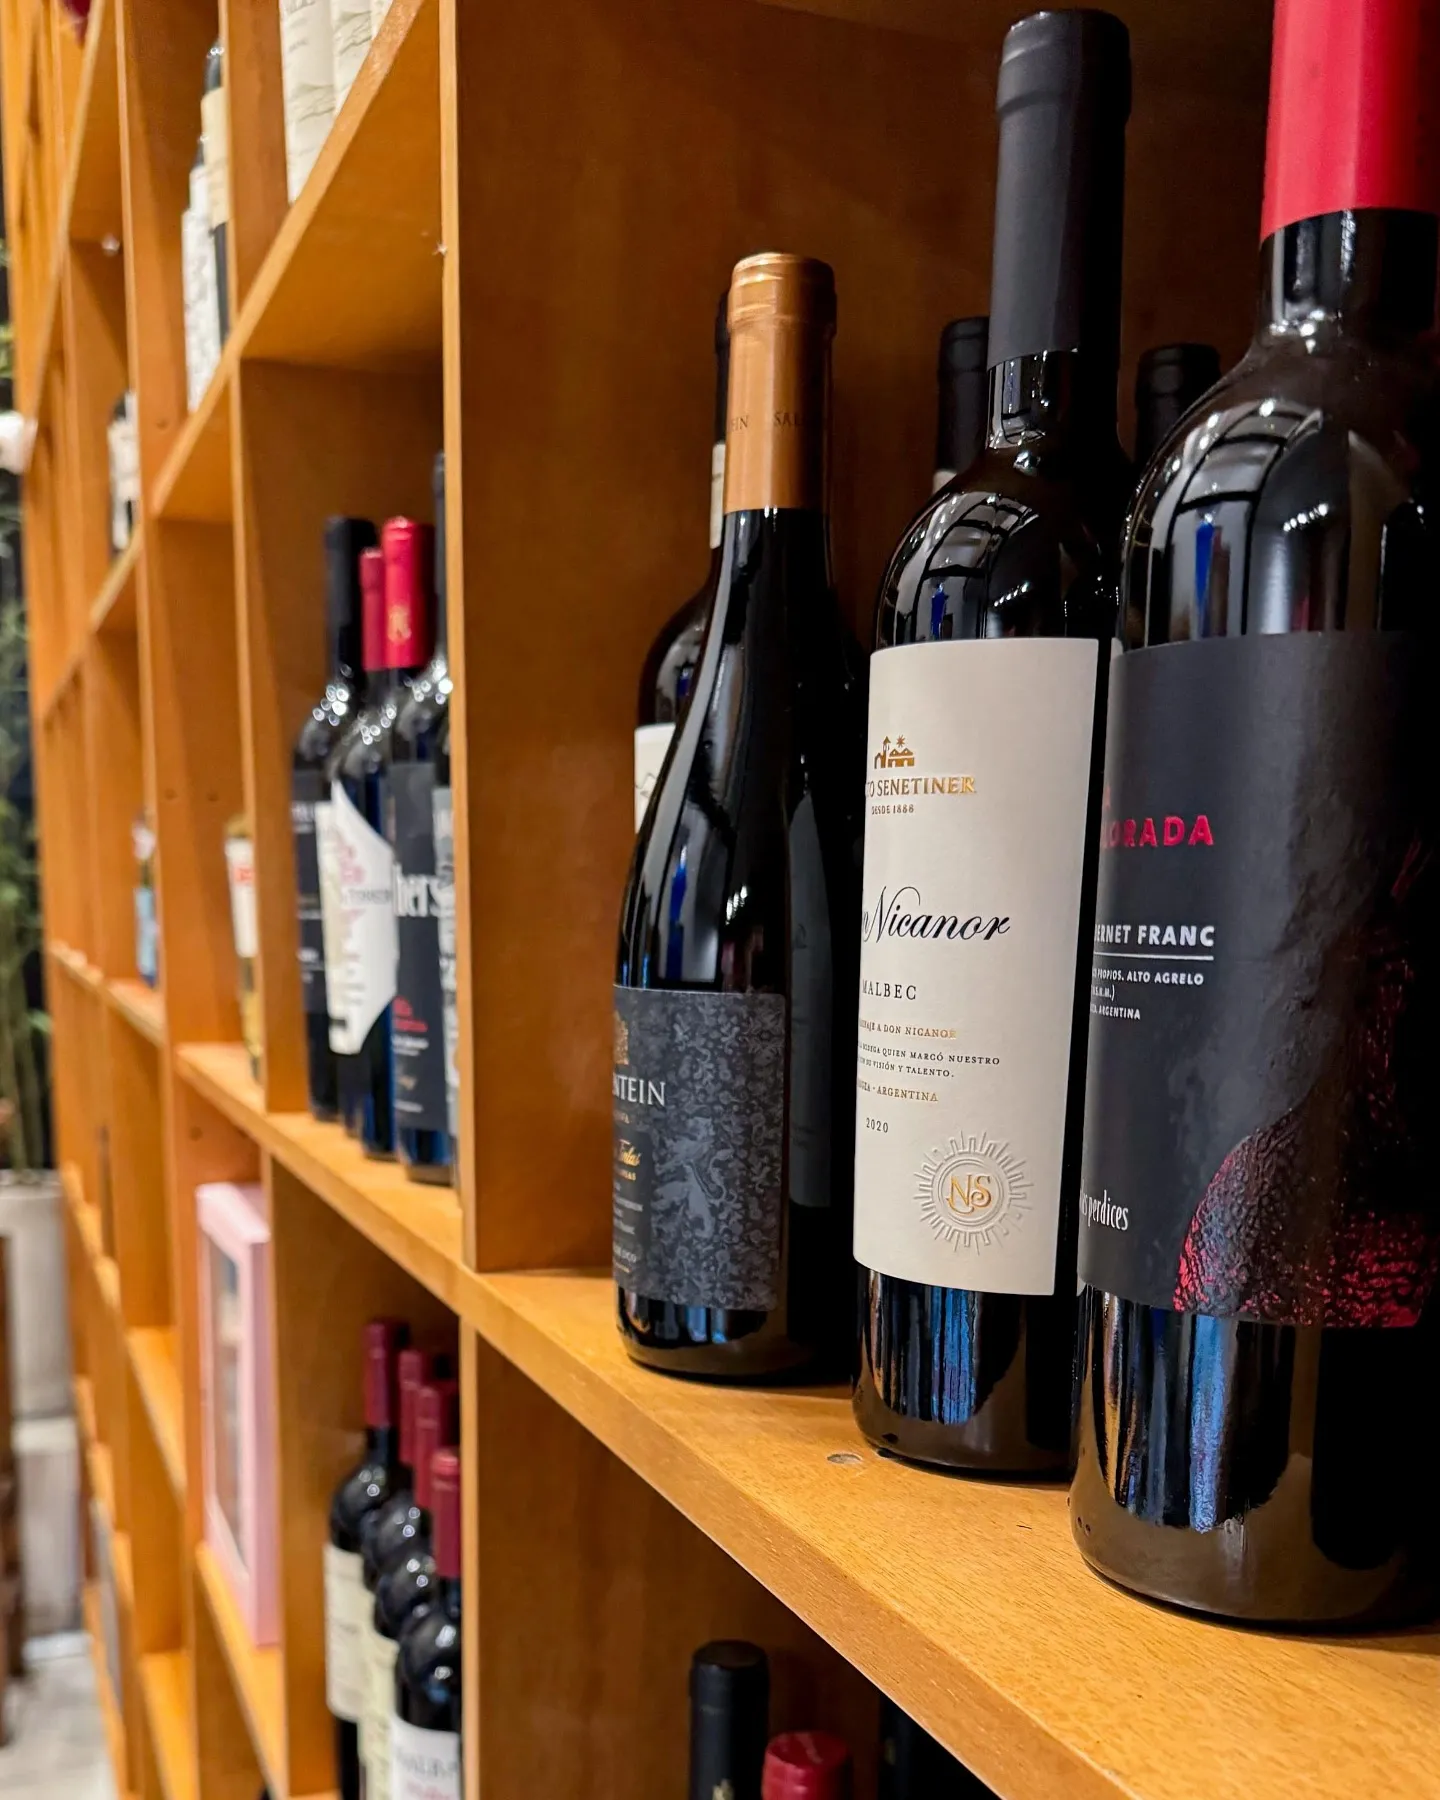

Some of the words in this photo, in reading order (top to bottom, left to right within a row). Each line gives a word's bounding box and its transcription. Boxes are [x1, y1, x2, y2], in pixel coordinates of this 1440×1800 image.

[877, 776, 976, 797] SENETINER
[871, 805, 890, 815] DESDE
[864, 886, 1011, 943] Nicanor
[1137, 925, 1215, 947] FRANC
[1127, 970, 1151, 983] ALTO
[1154, 972, 1204, 986] AGRELO
[862, 979, 917, 1001] MALBEC
[1099, 1004, 1141, 1020] ARGENTINA
[884, 1024, 901, 1034] DON
[905, 1026, 957, 1039] NICANOR
[882, 1047, 906, 1058] QUIEN
[910, 1051, 944, 1062] MARCÓ
[948, 1055, 1000, 1065] NUESTRO
[873, 1060, 895, 1071] VISIÓN
[898, 1065, 904, 1073] Y
[905, 1066, 955, 1078] TALENTO.
[876, 1085, 939, 1102] ARGENTINA
[866, 1117, 889, 1133] 2020
[945, 1173, 992, 1215] NS
[1088, 1189, 1129, 1231] perdices
